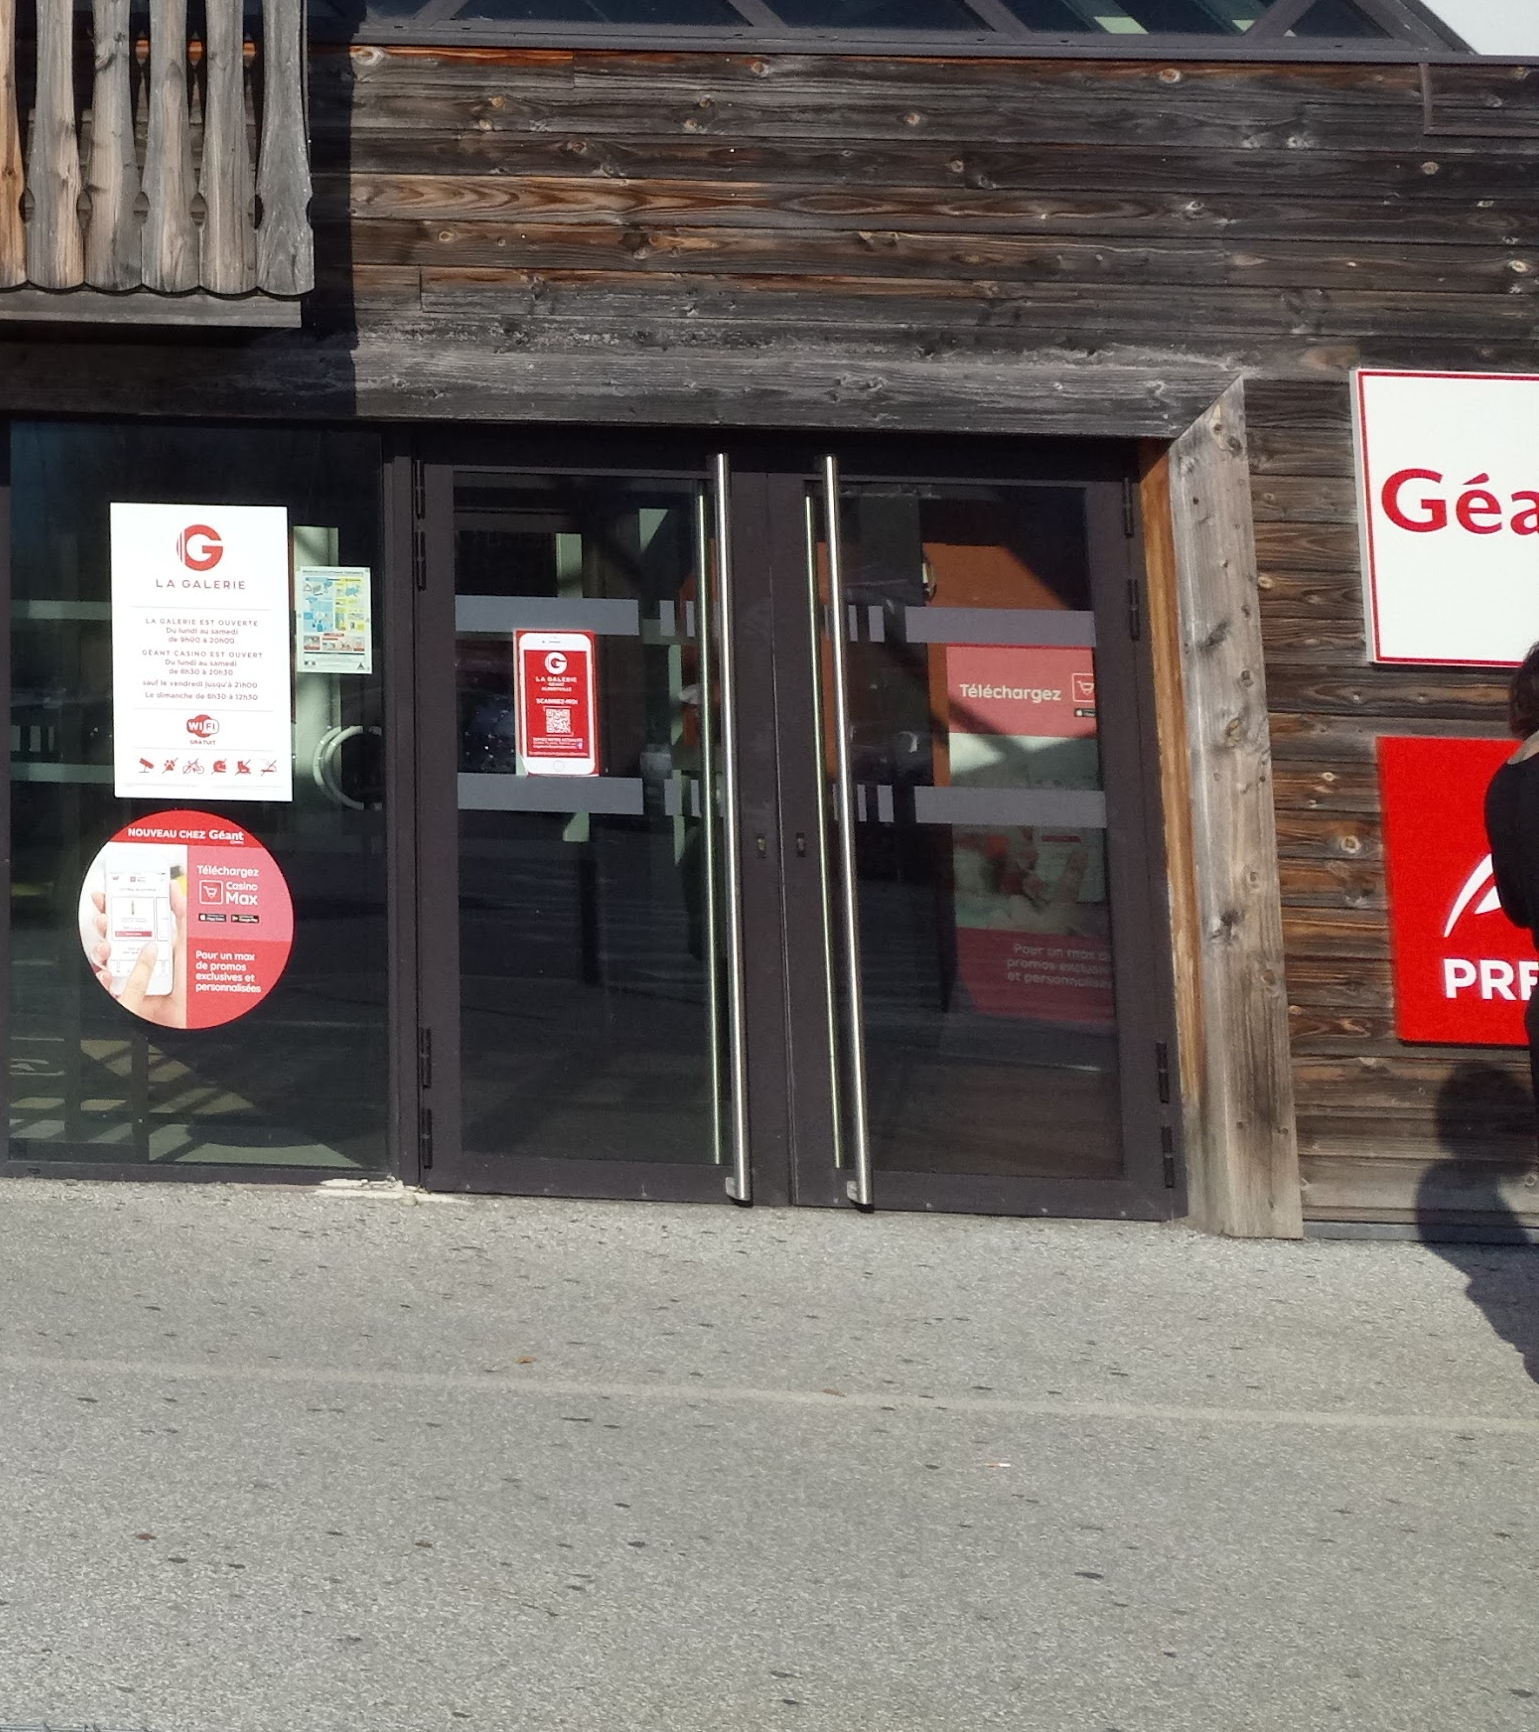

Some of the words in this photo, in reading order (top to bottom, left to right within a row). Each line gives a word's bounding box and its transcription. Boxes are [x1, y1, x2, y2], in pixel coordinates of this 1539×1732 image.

[155, 578, 176, 590] LA
[181, 579, 247, 591] GALERIE
[160, 618, 197, 626] GALERIE
[217, 620, 259, 628] OUVERTE
[178, 627, 198, 635] lundi
[210, 628, 239, 636] samedi
[168, 635, 178, 643] de
[209, 636, 235, 645] 20h00
[142, 648, 172, 658] GÉANT
[174, 650, 207, 658] CASINO
[210, 650, 226, 658] EST
[228, 651, 263, 659] OUVERT
[177, 659, 197, 667] lundi
[209, 659, 237, 668] samedi
[168, 667, 179, 676] de
[208, 668, 234, 677] 20h30
[142, 679, 159, 688] sauf
[160, 679, 168, 688] le
[169, 680, 203, 689] vendredi
[144, 691, 155, 699] Le
[156, 691, 194, 699] dimanche
[195, 692, 205, 700] de
[958, 682, 1062, 704] Téléchargez
[127, 827, 178, 839] NOUVEAU
[178, 829, 206, 839] CHEZ
[208, 828, 245, 842] Géant
[196, 864, 260, 879] Téléchargez
[225, 880, 259, 892] Casino
[225, 892, 259, 907] Max
[1013, 942, 1045, 956] Pour
[195, 949, 218, 961] Pour
[220, 951, 232, 961] un
[234, 951, 256, 962] max
[195, 960, 209, 970] de
[210, 961, 247, 972] promos
[1006, 958, 1057, 971] promos
[195, 972, 243, 983] exclusives
[244, 973, 256, 983] et
[1006, 971, 1022, 982] et
[195, 982, 262, 995] personnalisées
